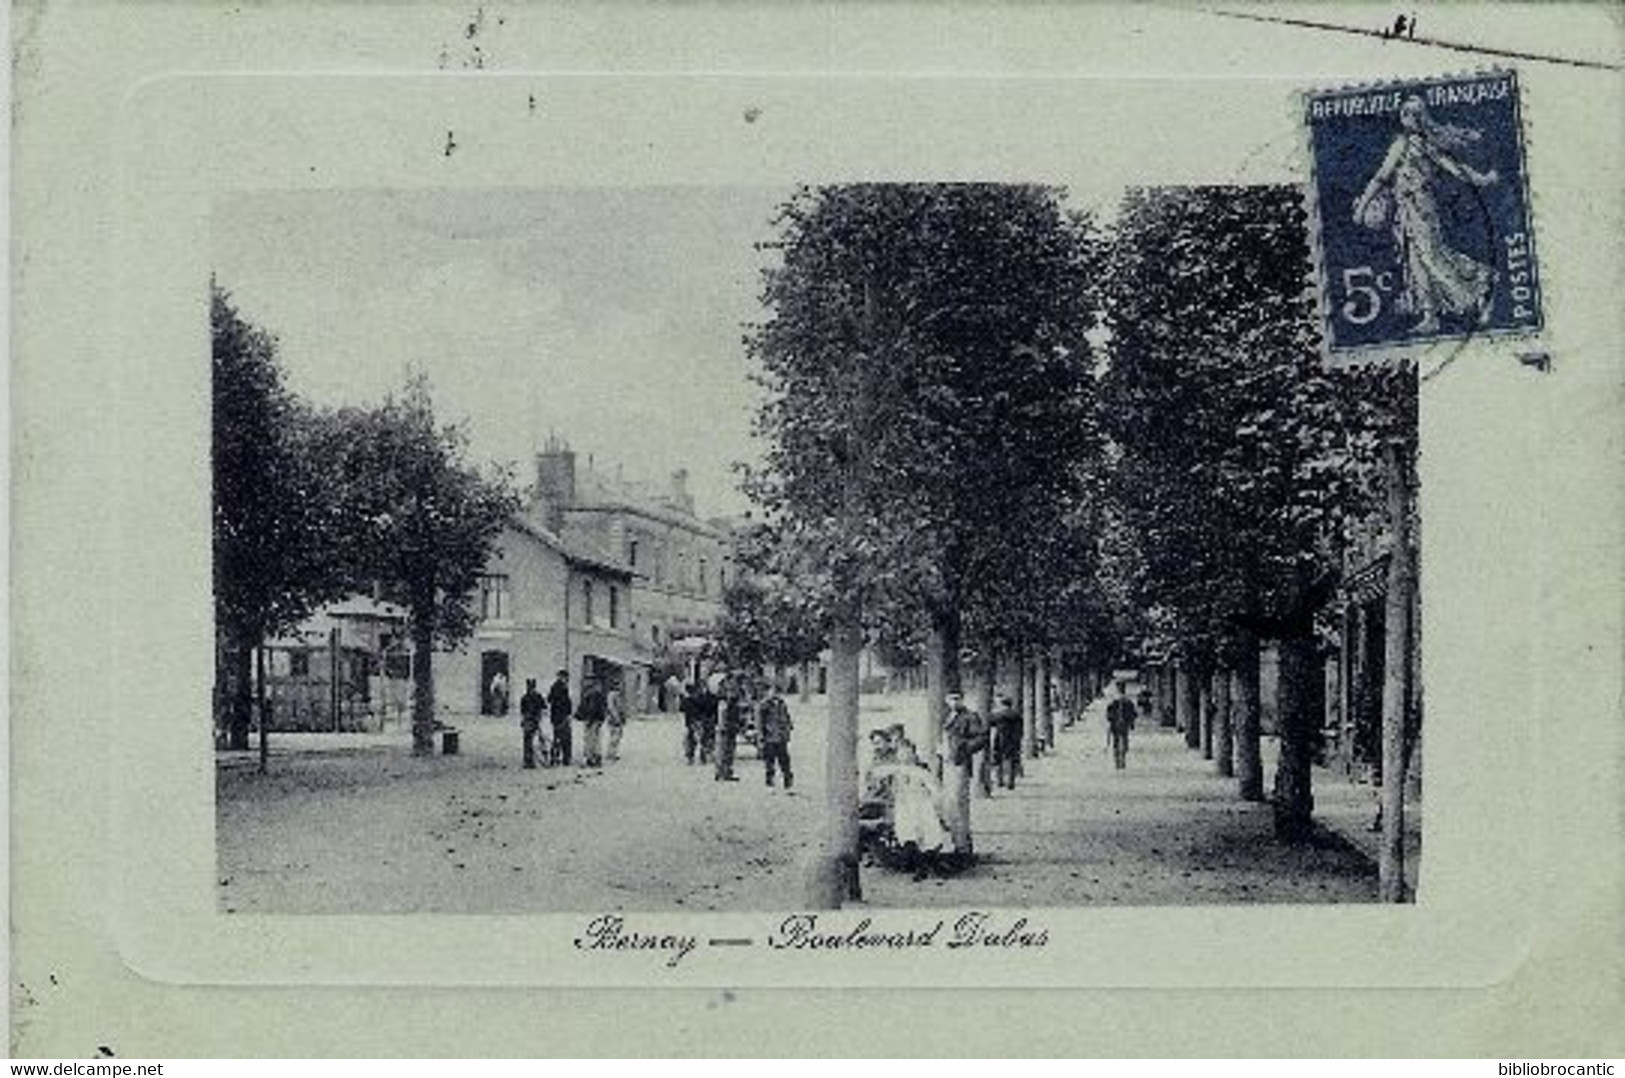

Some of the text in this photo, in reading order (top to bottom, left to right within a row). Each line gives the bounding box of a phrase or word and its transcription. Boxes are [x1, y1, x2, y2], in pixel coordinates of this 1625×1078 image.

[1505, 232, 1533, 319] POSTES
[573, 915, 697, 968] Bernay
[768, 914, 944, 949] Boulevard
